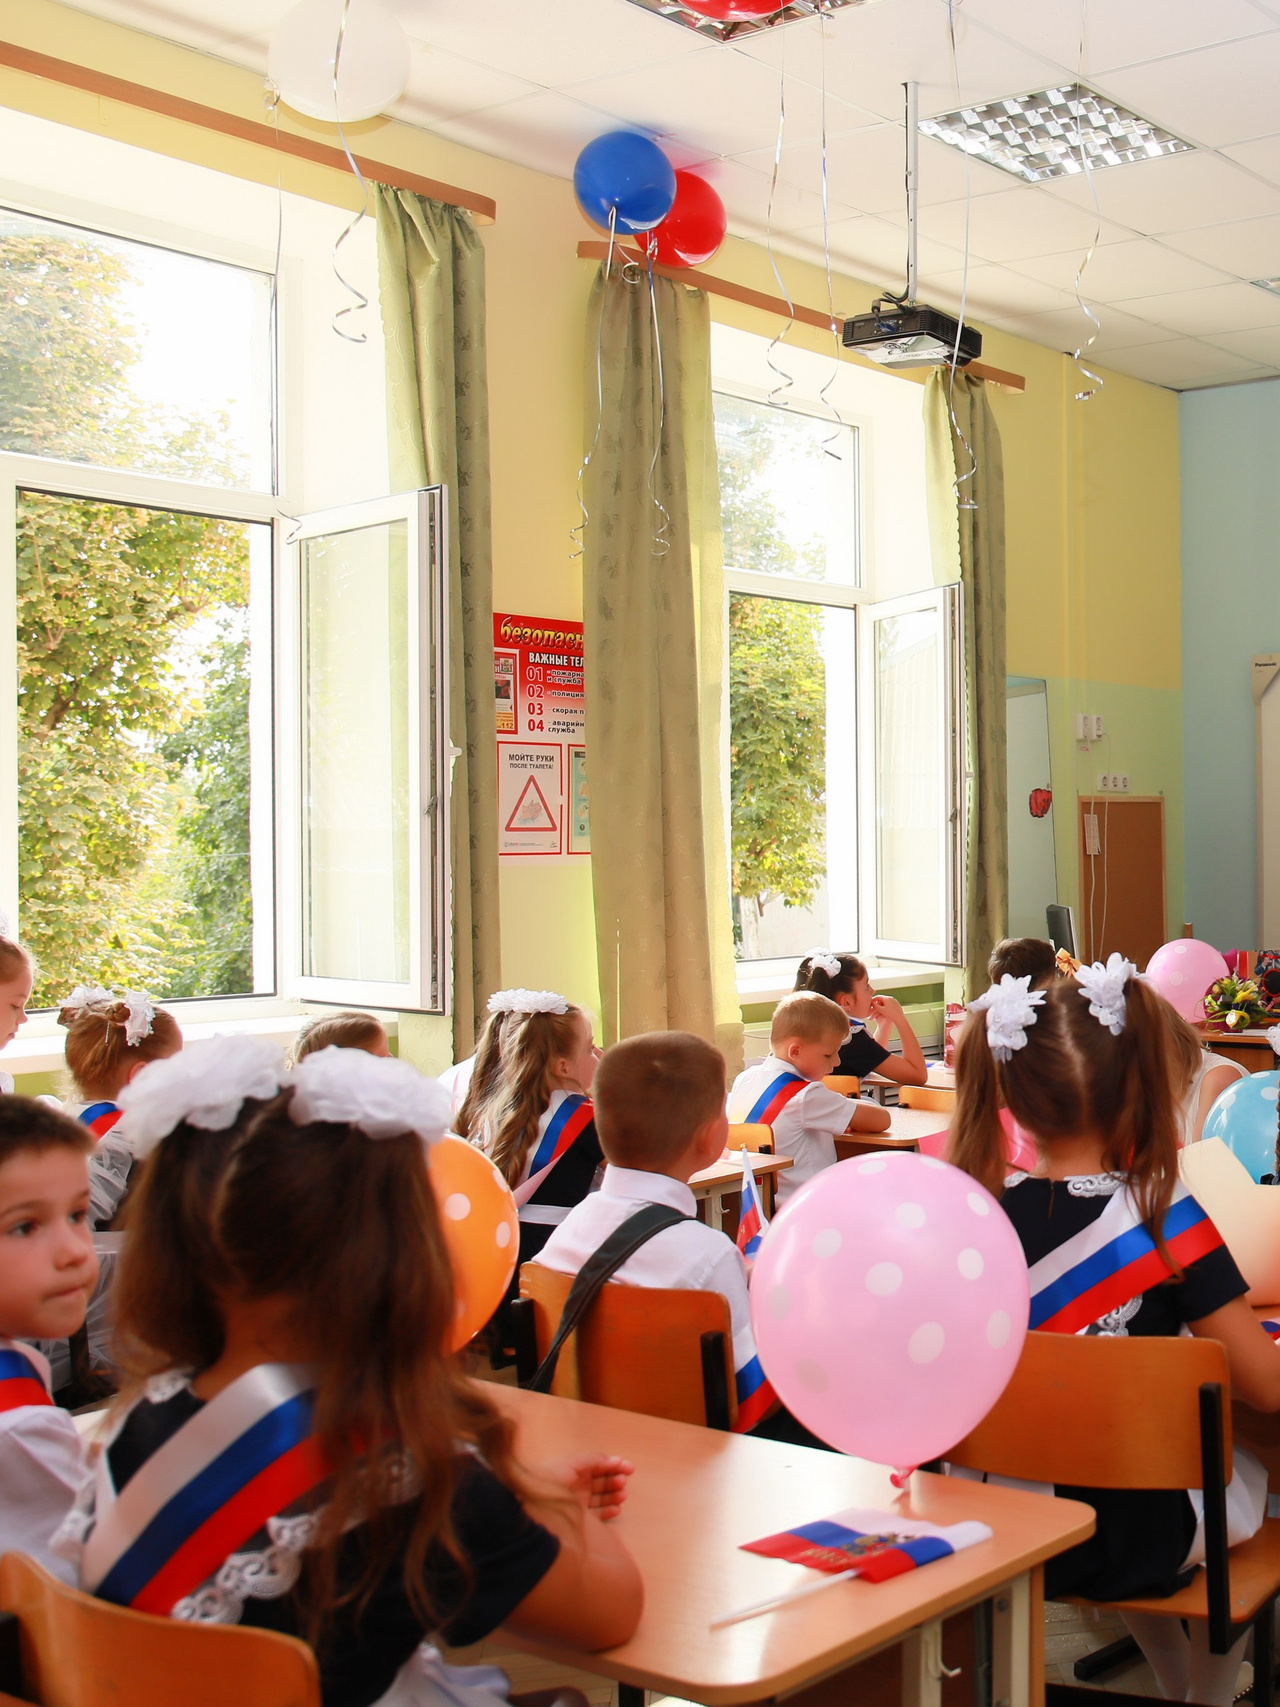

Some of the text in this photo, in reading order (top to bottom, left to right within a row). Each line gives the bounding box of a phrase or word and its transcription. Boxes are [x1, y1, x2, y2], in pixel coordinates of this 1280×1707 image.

[528, 652, 568, 667] ВАЖНЫЕ
[526, 666, 545, 682] 01
[526, 684, 545, 699] 02
[527, 702, 544, 716] 03
[552, 707, 577, 715] скорая
[527, 718, 545, 732] 04
[548, 726, 575, 734] служба
[509, 753, 534, 762] МОЙТЕ
